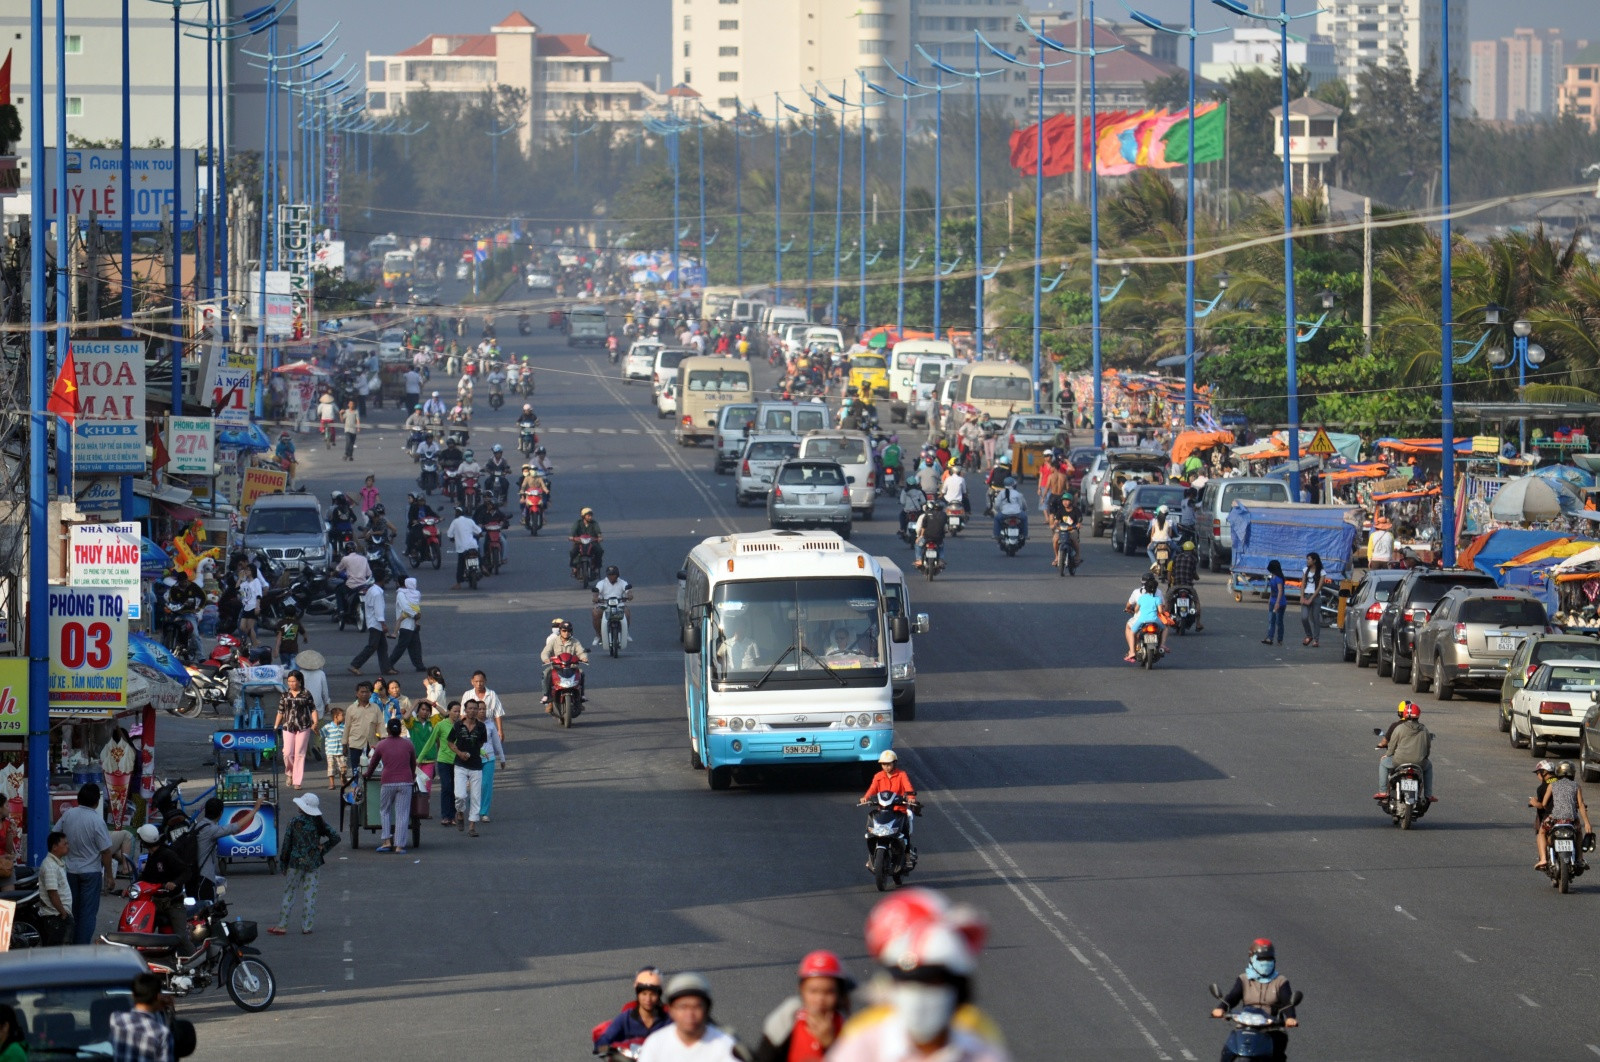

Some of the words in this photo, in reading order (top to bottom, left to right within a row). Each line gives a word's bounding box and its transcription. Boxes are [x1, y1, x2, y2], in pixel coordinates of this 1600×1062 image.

[89, 155, 149, 170] AGRIANK
[92, 184, 116, 218] LỆ
[283, 206, 308, 250] THU
[72, 343, 110, 354] KHÁCH
[114, 345, 139, 355] SẠN
[74, 361, 137, 387] HOA
[75, 395, 134, 420] MAI
[175, 434, 208, 454] 27A
[80, 524, 103, 533] NHÀ
[106, 523, 133, 533] NGHỈ
[49, 589, 95, 617] PHÒNG
[98, 594, 123, 622] TRỌ
[60, 621, 113, 670] 03
[58, 676, 66, 689] XE
[86, 672, 104, 689] NƯỚC
[238, 734, 268, 746] pepsi
[230, 844, 264, 856] pepsi
